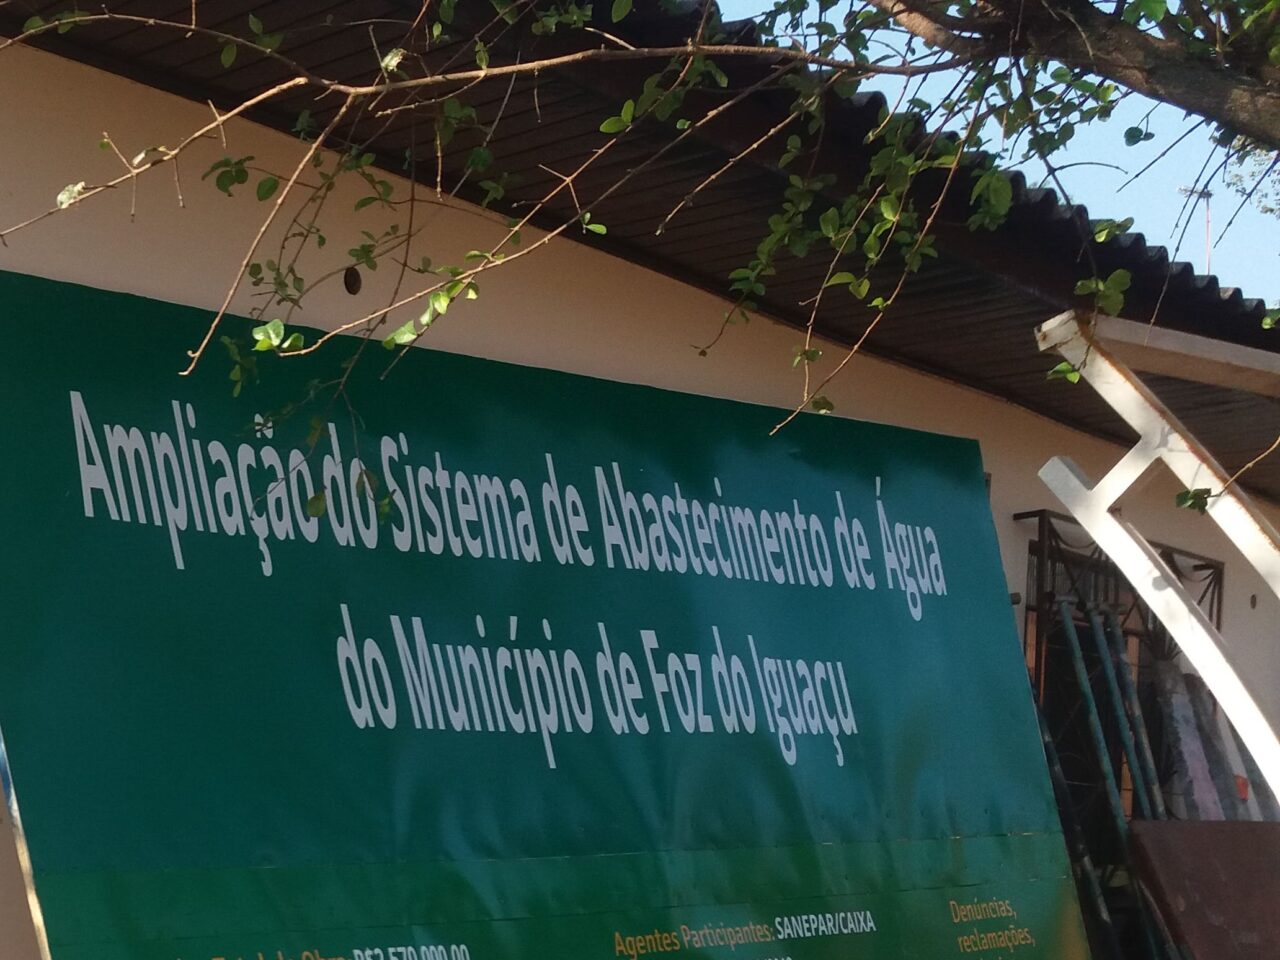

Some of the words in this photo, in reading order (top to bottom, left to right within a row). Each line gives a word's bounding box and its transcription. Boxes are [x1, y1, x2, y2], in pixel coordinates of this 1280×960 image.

[70, 390, 319, 577] Ampliação
[323, 422, 378, 549] do
[381, 432, 541, 563] Sistema
[542, 453, 595, 566] de
[595, 462, 833, 587] Abastecimento
[835, 491, 876, 590] de
[876, 477, 947, 621] Água
[337, 604, 397, 729] do
[390, 614, 593, 768] Município
[596, 622, 650, 735] de
[640, 630, 714, 734] Foz
[711, 626, 756, 735] do
[747, 635, 858, 767] Iguaçu
[680, 921, 775, 952] Participantes:
[774, 910, 876, 940] SANEPAR/CAIXA
[949, 897, 1017, 923] Denúncias,
[957, 925, 1036, 952] reclamações,
